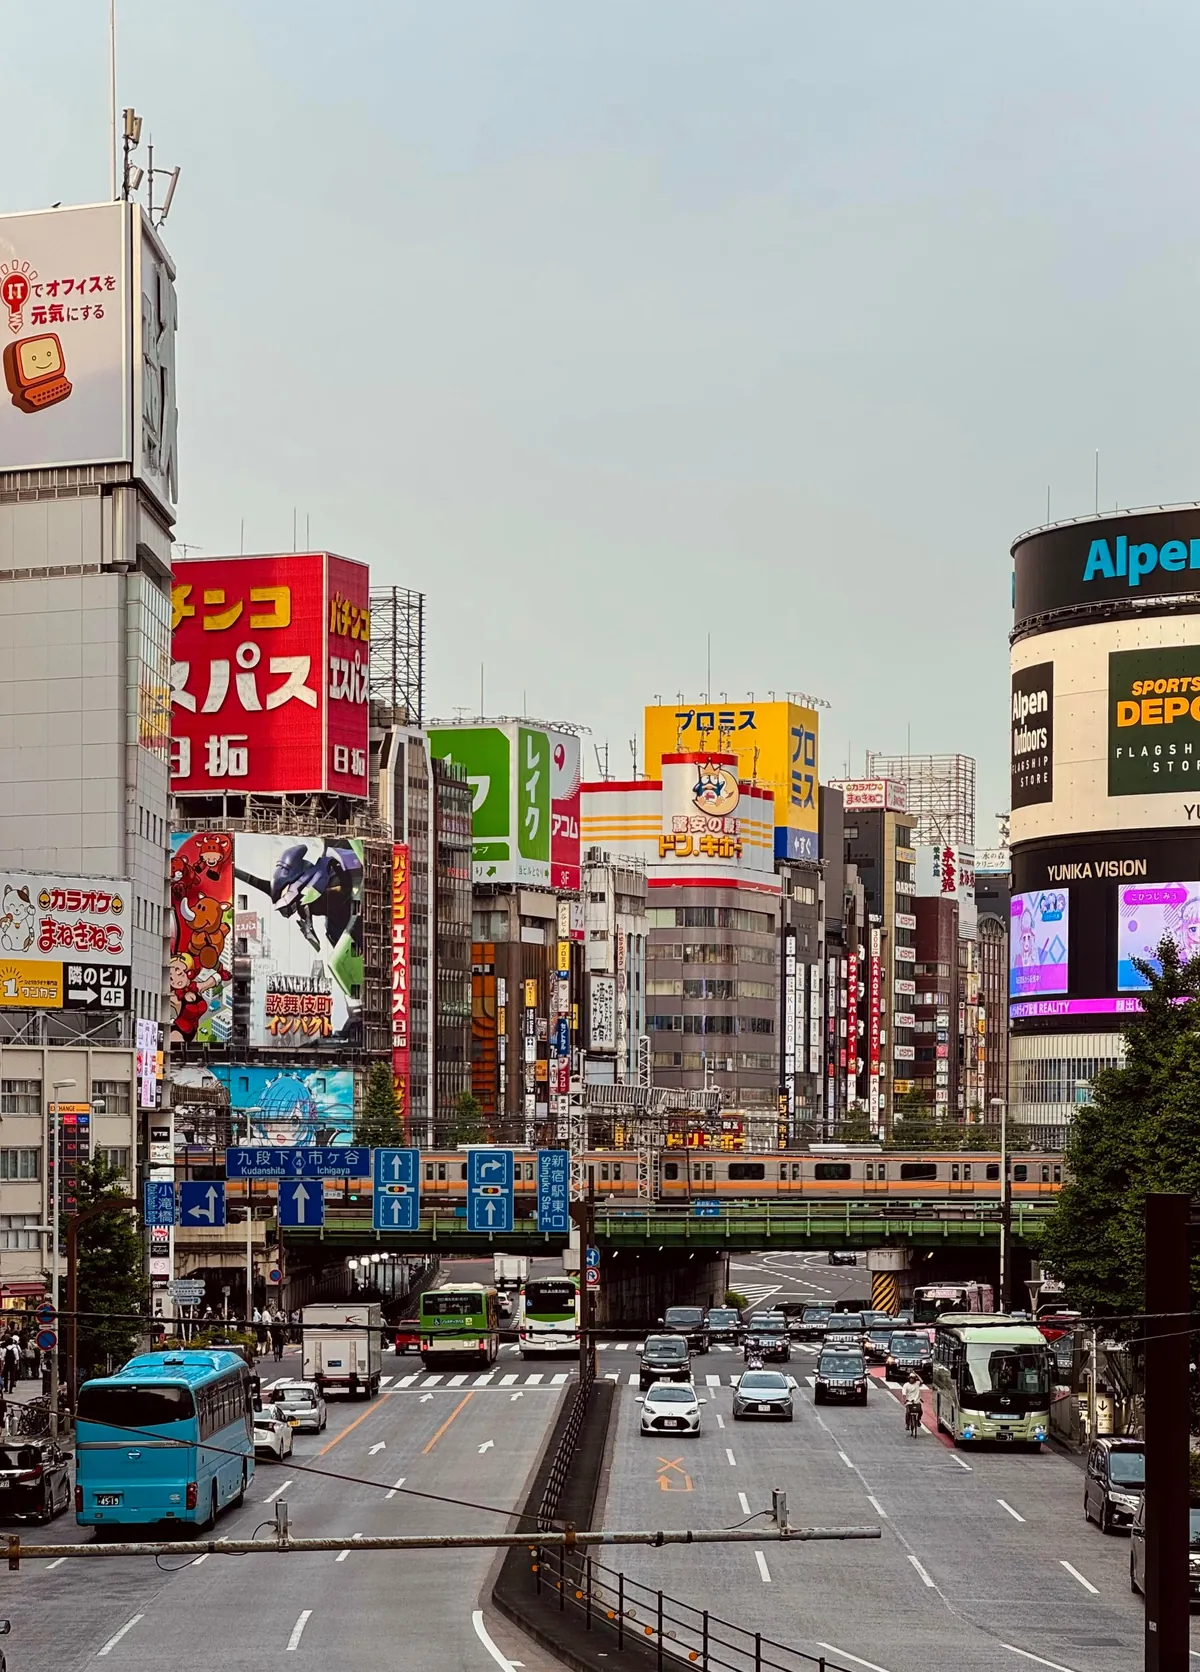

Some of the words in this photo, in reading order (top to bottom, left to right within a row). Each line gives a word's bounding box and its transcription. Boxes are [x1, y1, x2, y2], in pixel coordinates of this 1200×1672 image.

[7, 283, 24, 300] IT
[32, 276, 116, 298] でオフィスを
[31, 304, 105, 325] 元気にする
[330, 591, 369, 641] パチンコ
[329, 650, 369, 704] エスパス
[1012, 689, 1048, 725] Alpen
[675, 709, 756, 731] プロミス
[334, 744, 365, 776] 日拓
[525, 735, 540, 840] レイク
[852, 783, 878, 791] カラオケ
[1020, 772, 1048, 787] STORE
[552, 814, 579, 839] アコム
[1047, 862, 1092, 881] YUNIKA
[1094, 859, 1147, 878] VISION
[393, 855, 407, 919] パチンコ
[896, 881, 916, 895] DARTS
[1131, 892, 1160, 902] こひつじ
[51, 889, 112, 913] カラオケ
[38, 915, 124, 954] まねきねこ
[68, 965, 128, 987] 隣のビル
[393, 924, 407, 1013] エスパス
[21, 987, 58, 999] ワンカラ
[103, 990, 122, 1004] 4F
[266, 995, 333, 1015] 歌舞伎町
[1038, 1002, 1070, 1014] REALITY
[266, 1015, 333, 1036] インパクト
[237, 1150, 290, 1166] 九段下
[296, 1159, 302, 1167] 4
[241, 1166, 285, 1175] Kudanshita
[317, 1166, 351, 1177] Ichigaya
[541, 1156, 551, 1195] Shinjuku
[552, 1154, 564, 1227] 新宿駅東口
[158, 1185, 173, 1223] 小滝橋
